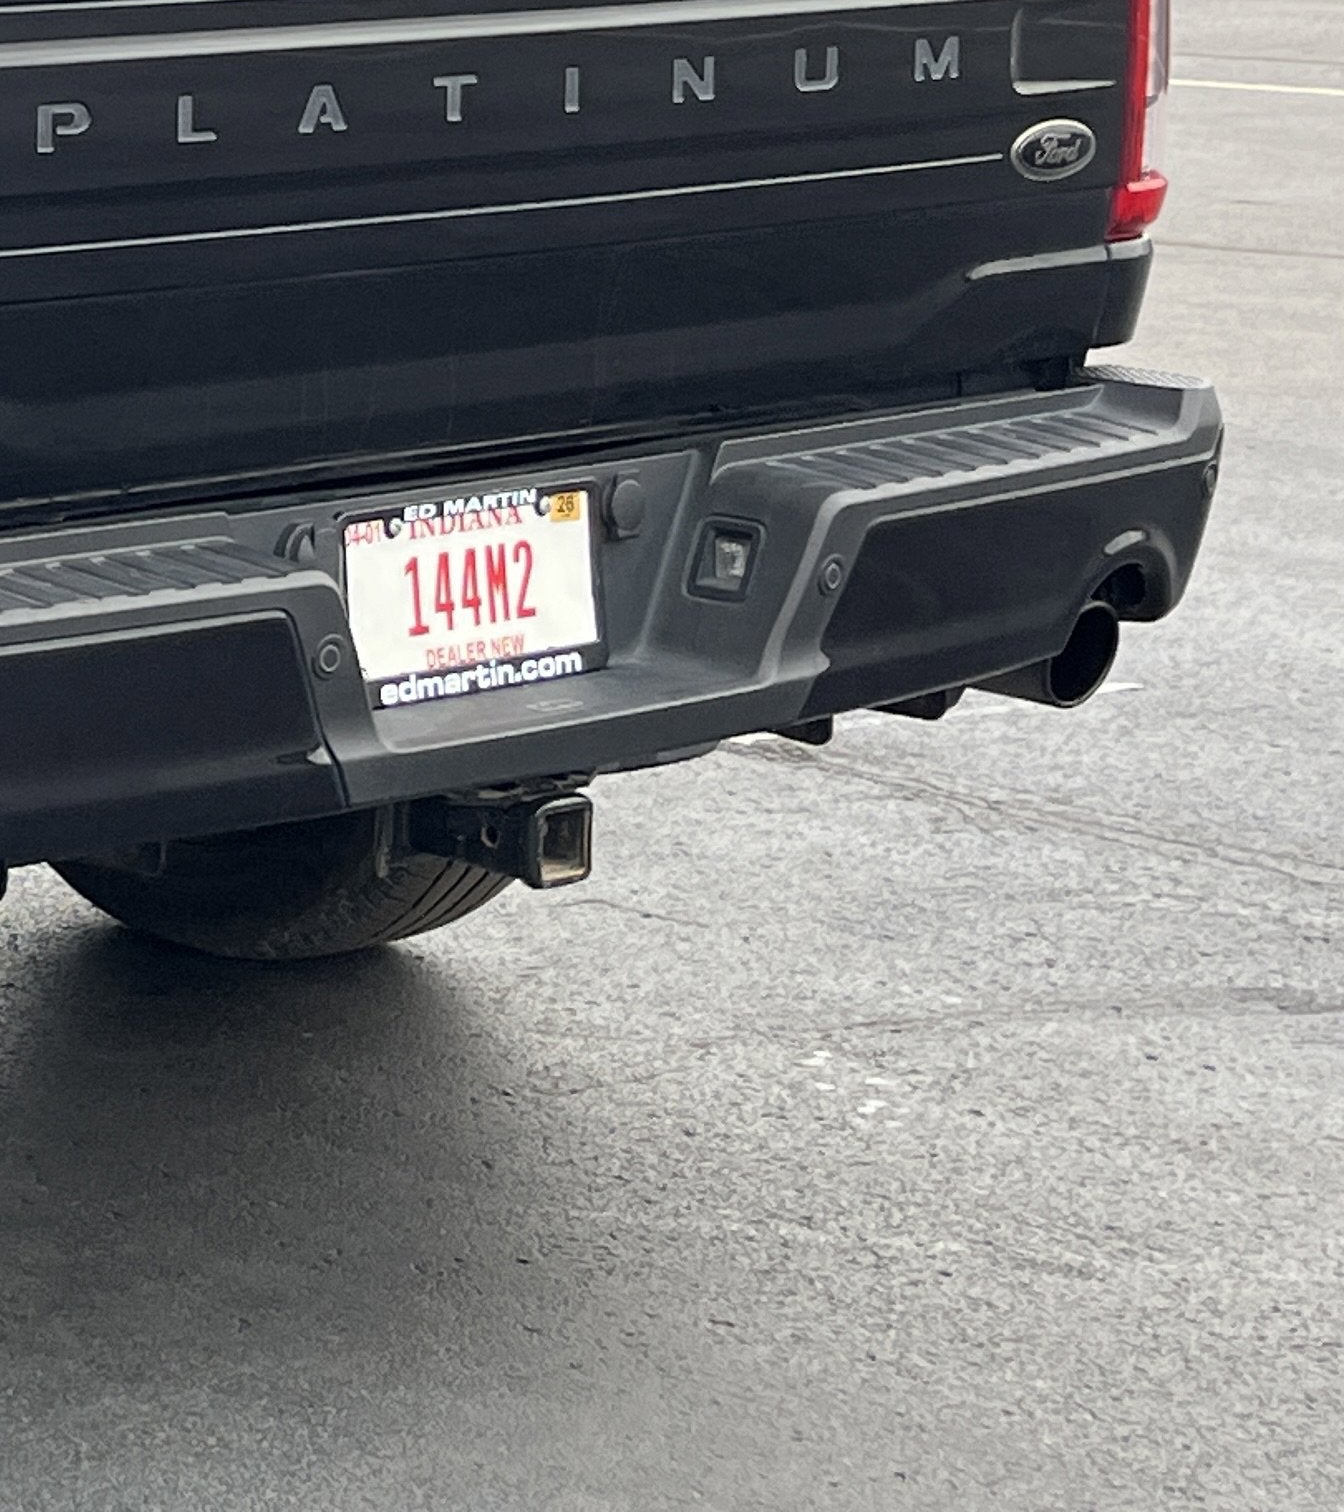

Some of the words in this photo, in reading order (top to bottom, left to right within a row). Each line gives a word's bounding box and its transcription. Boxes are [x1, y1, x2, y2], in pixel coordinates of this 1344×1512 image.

[36, 35, 961, 153] PLATINUM
[403, 504, 437, 521] ED
[443, 488, 537, 516] MARTIN
[409, 504, 523, 539] INDIANA
[404, 539, 537, 637] 144M2
[425, 640, 486, 669] DEALER
[490, 634, 525, 659] NEW
[379, 650, 583, 705] edmartin.com
